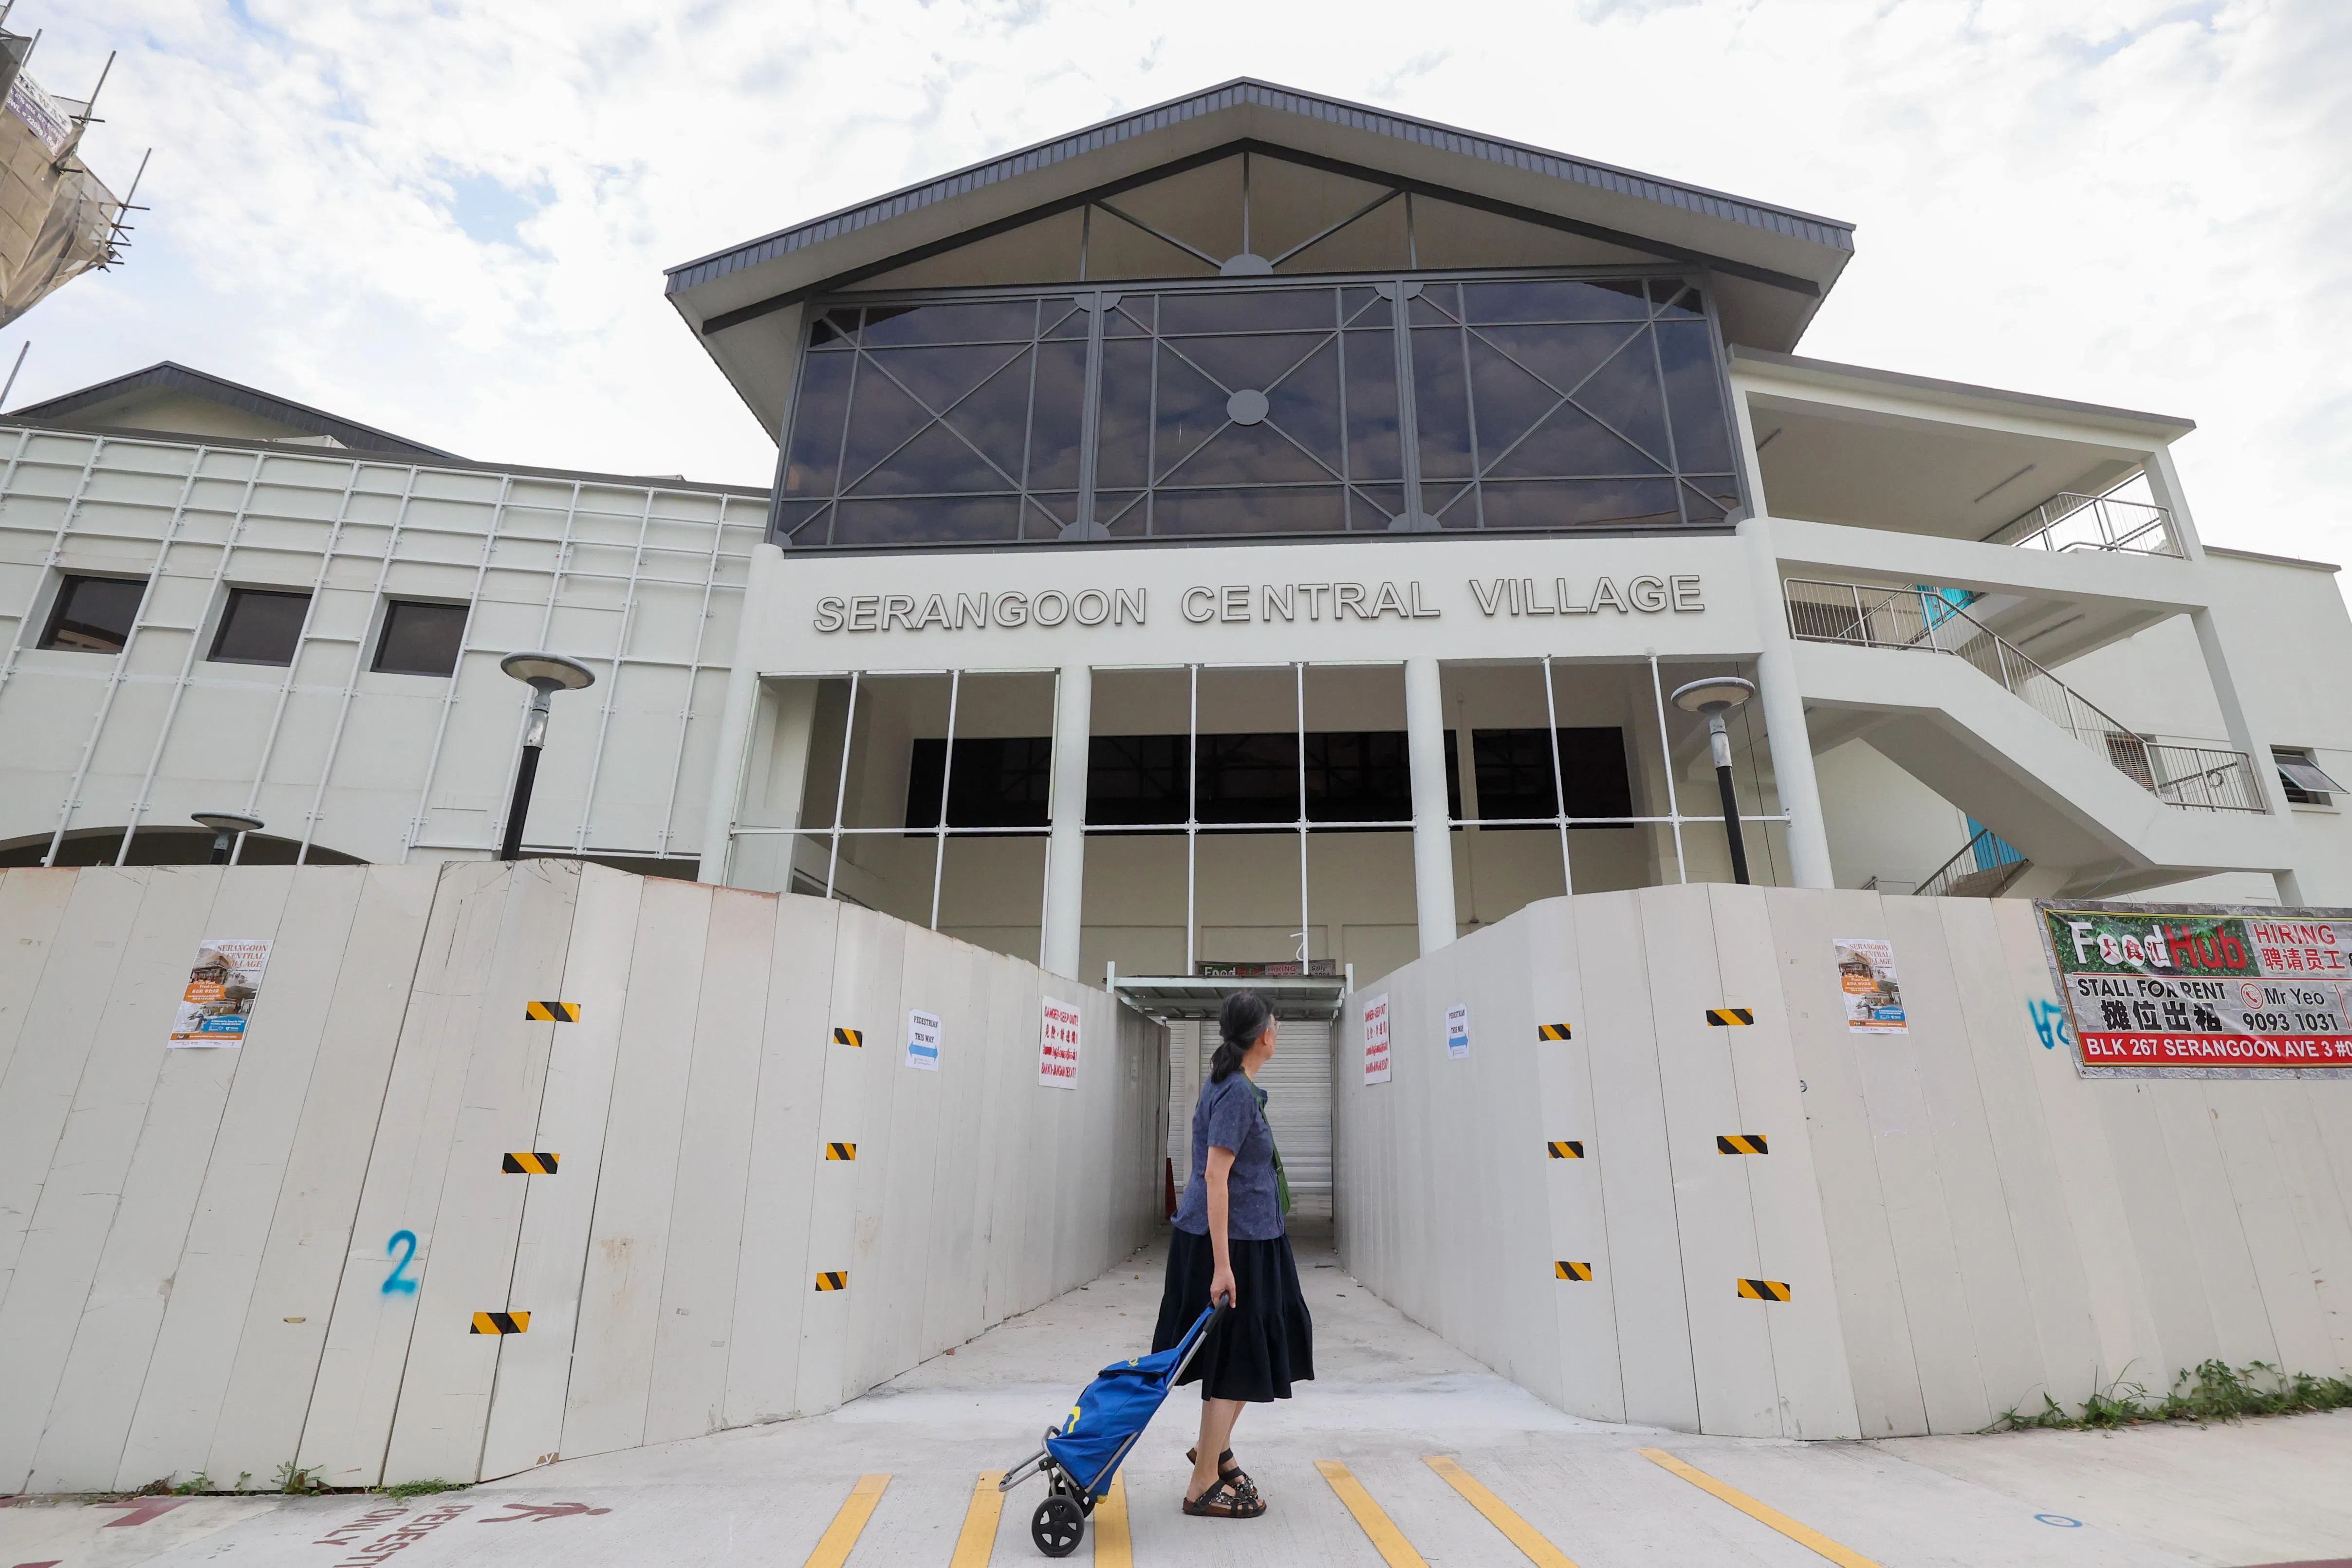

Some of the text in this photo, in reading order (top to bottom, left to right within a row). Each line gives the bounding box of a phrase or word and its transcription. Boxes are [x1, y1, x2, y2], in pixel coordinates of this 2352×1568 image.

[813, 575, 1705, 632] SERANGOON CENTRAL VILLAGE
[2253, 923, 2336, 945] HIRING
[2260, 947, 2346, 971] 聘请员工
[2077, 978, 2226, 999] STALL FOR RENT
[2264, 988, 2325, 1005] Mr Yeo
[914, 1015, 938, 1028] PEDESTRIAN
[1449, 1010, 1465, 1019] PEDESTRIAN
[2100, 999, 2222, 1032] 摊位出租
[2242, 1013, 2338, 1031] 9093 1031
[915, 1033, 934, 1043] THIS WAY
[2086, 1038, 2127, 1055] BLK
[2130, 1039, 2158, 1055] 267
[2164, 1039, 2281, 1057] SERANGOON
[2285, 1041, 2319, 1057] AVE
[2323, 1040, 2333, 1057] 3
[381, 1229, 418, 1294] 2
[312, 1508, 409, 1546] ONLY
